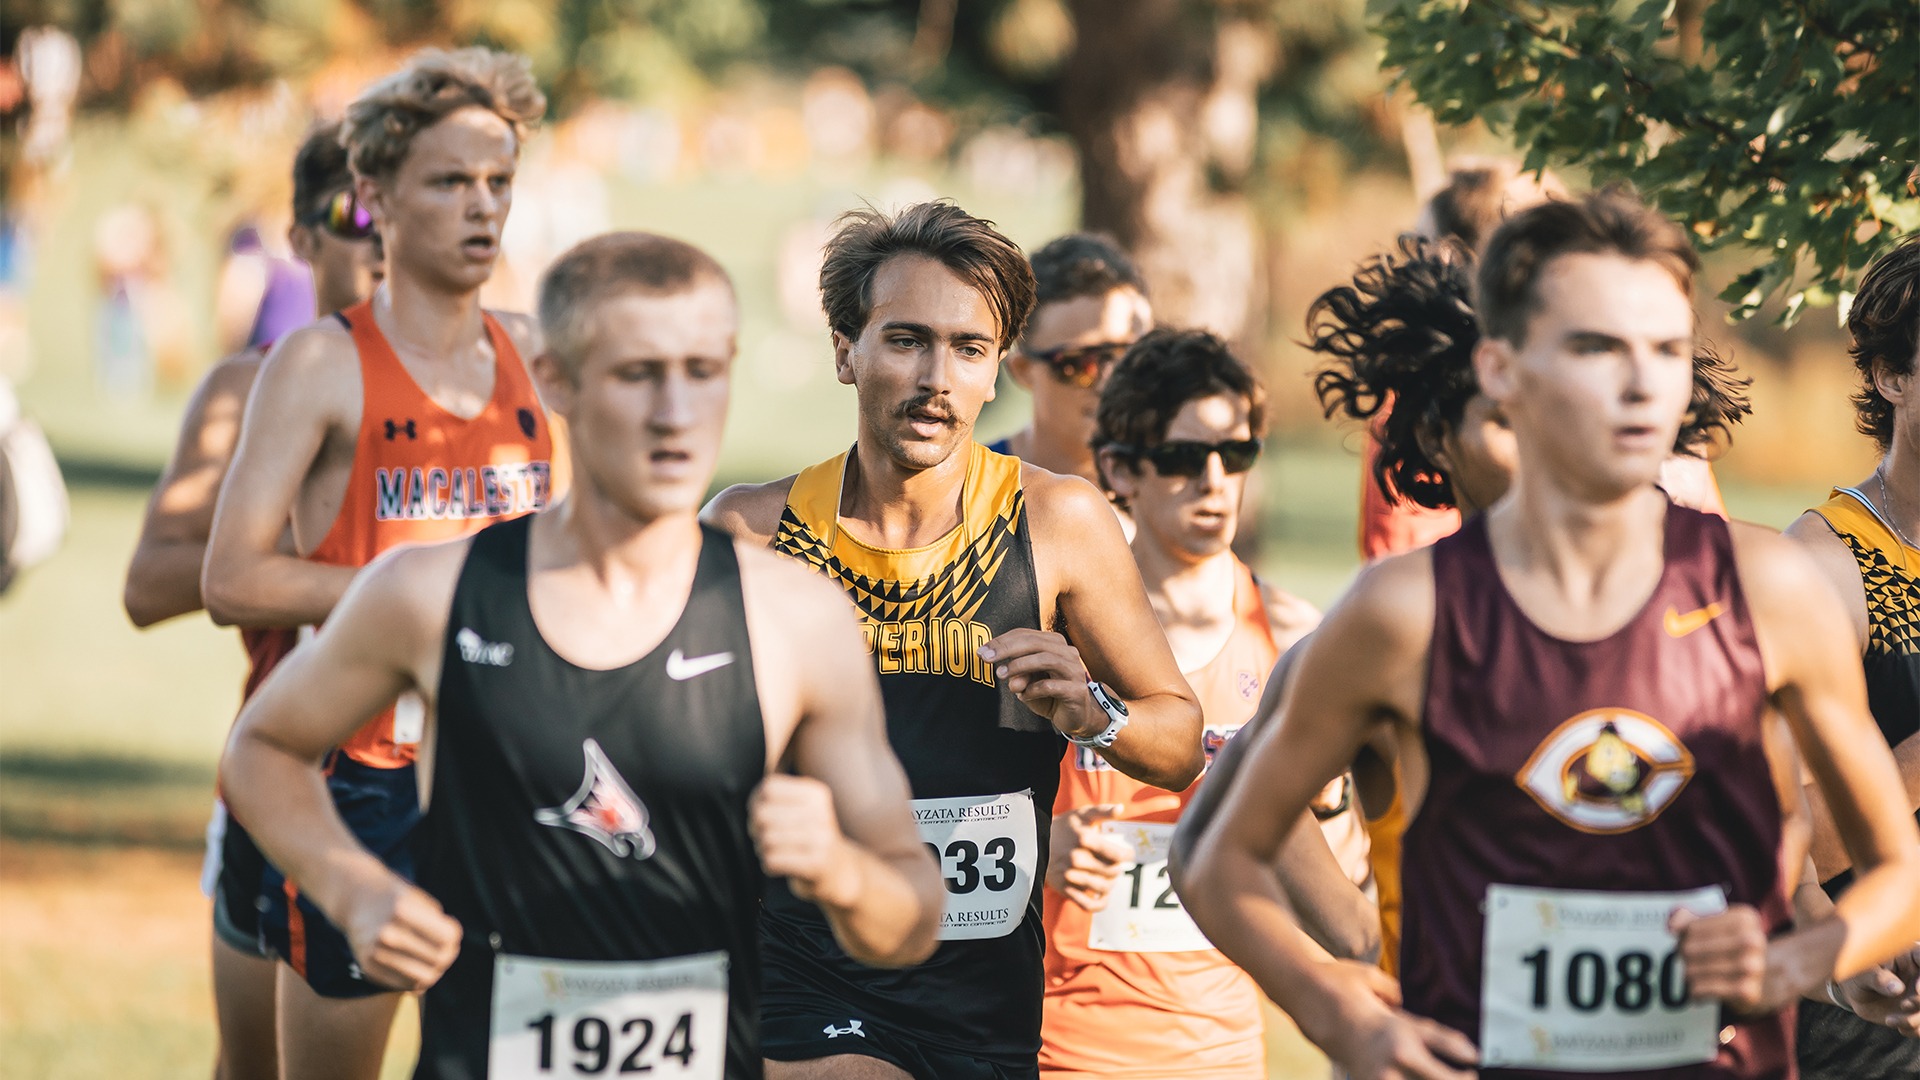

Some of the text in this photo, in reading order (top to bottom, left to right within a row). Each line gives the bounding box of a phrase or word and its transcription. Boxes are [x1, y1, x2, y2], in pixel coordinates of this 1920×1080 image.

[857, 617, 995, 688] PERIOR
[911, 804, 1010, 820] YZATA RESULTS
[921, 837, 1017, 894] 33
[1124, 864, 1180, 909] 12
[958, 907, 1009, 922] RESULTS
[1522, 948, 1689, 1012] 1080
[527, 1011, 695, 1075] 1924
